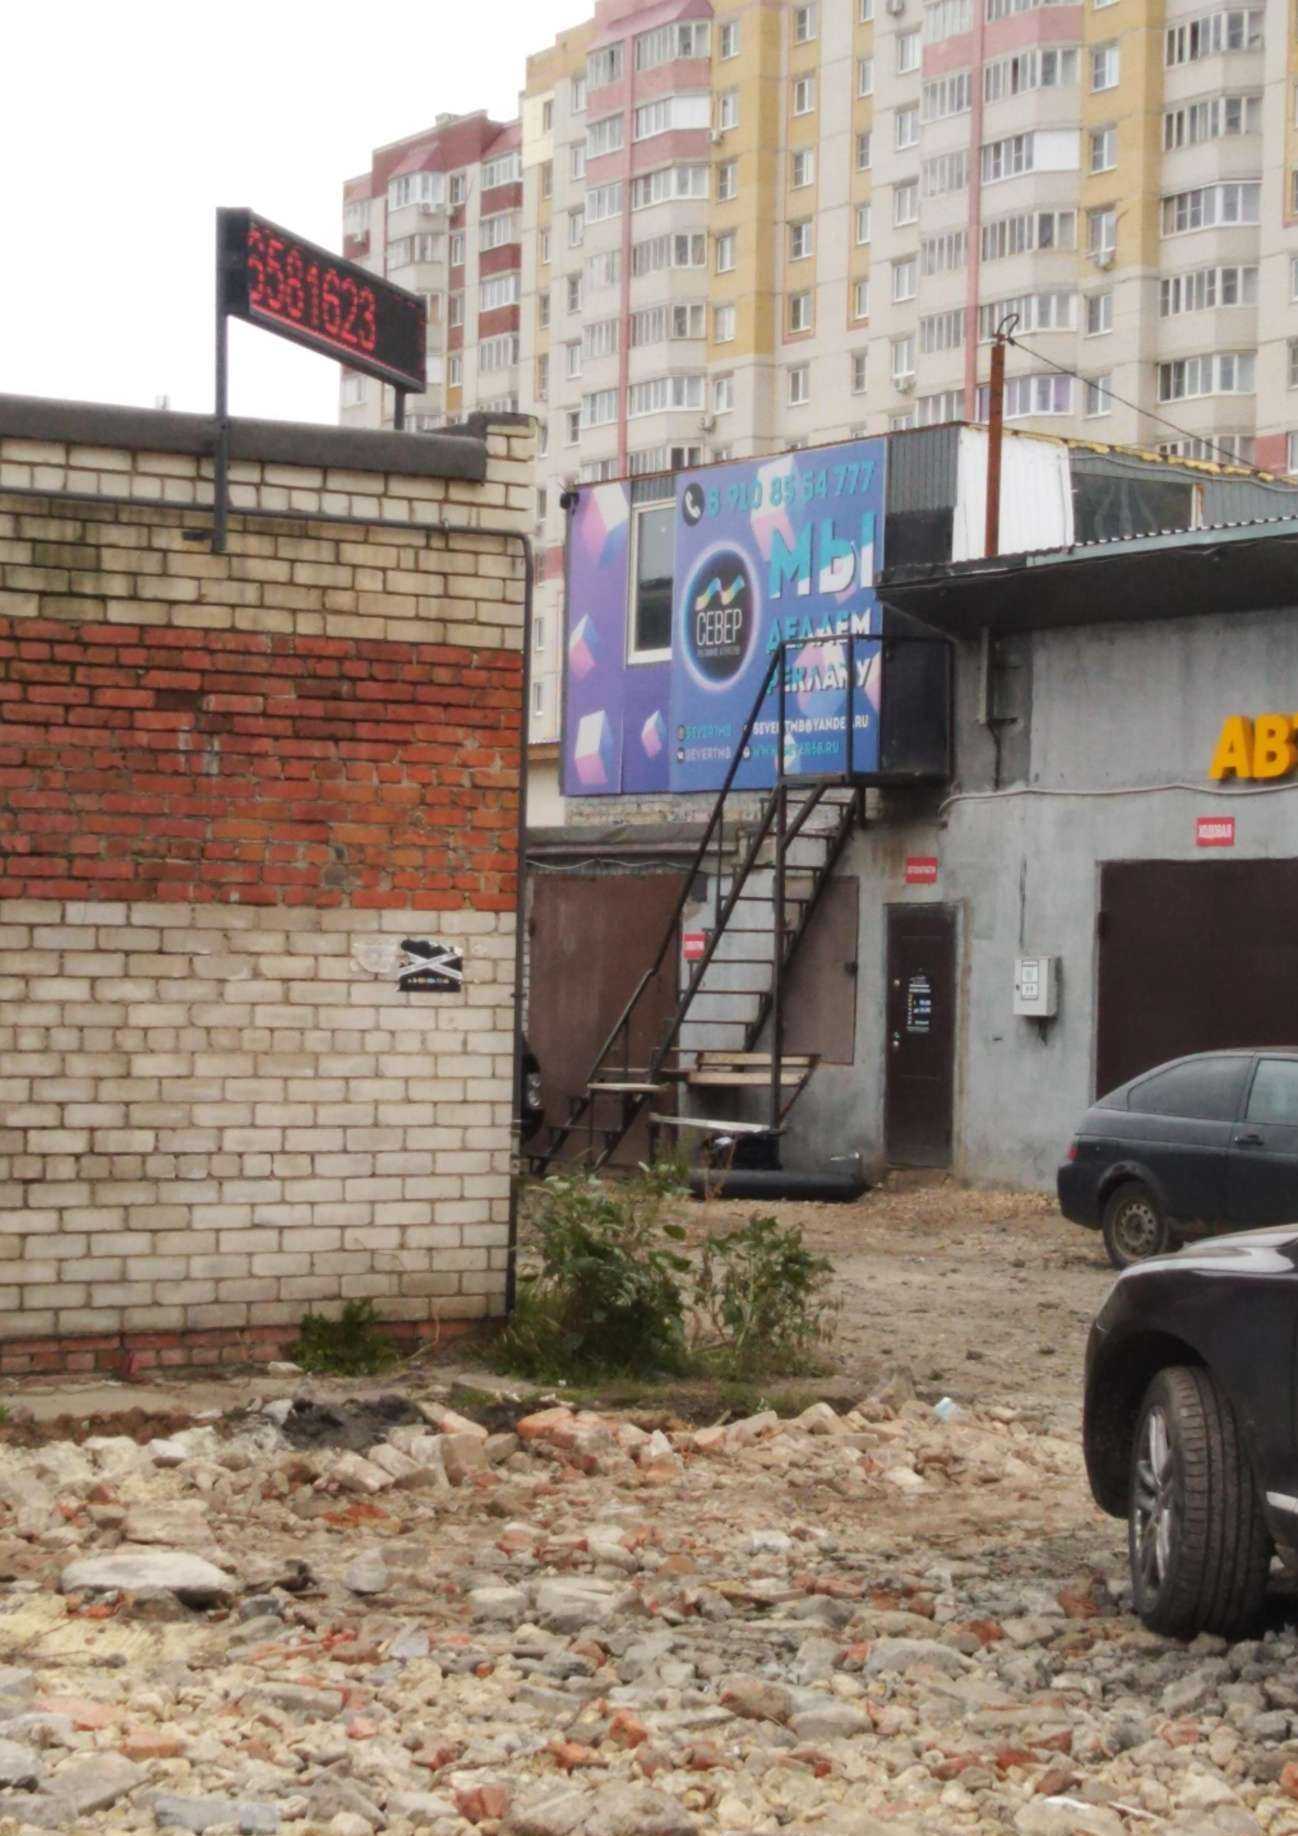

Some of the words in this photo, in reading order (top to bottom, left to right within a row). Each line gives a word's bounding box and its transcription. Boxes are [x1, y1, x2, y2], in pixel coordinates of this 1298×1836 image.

[832, 459, 876, 497] 777
[768, 510, 872, 600] МЫ
[697, 609, 742, 646] СЕВЕР
[1208, 713, 1298, 780] АВ
